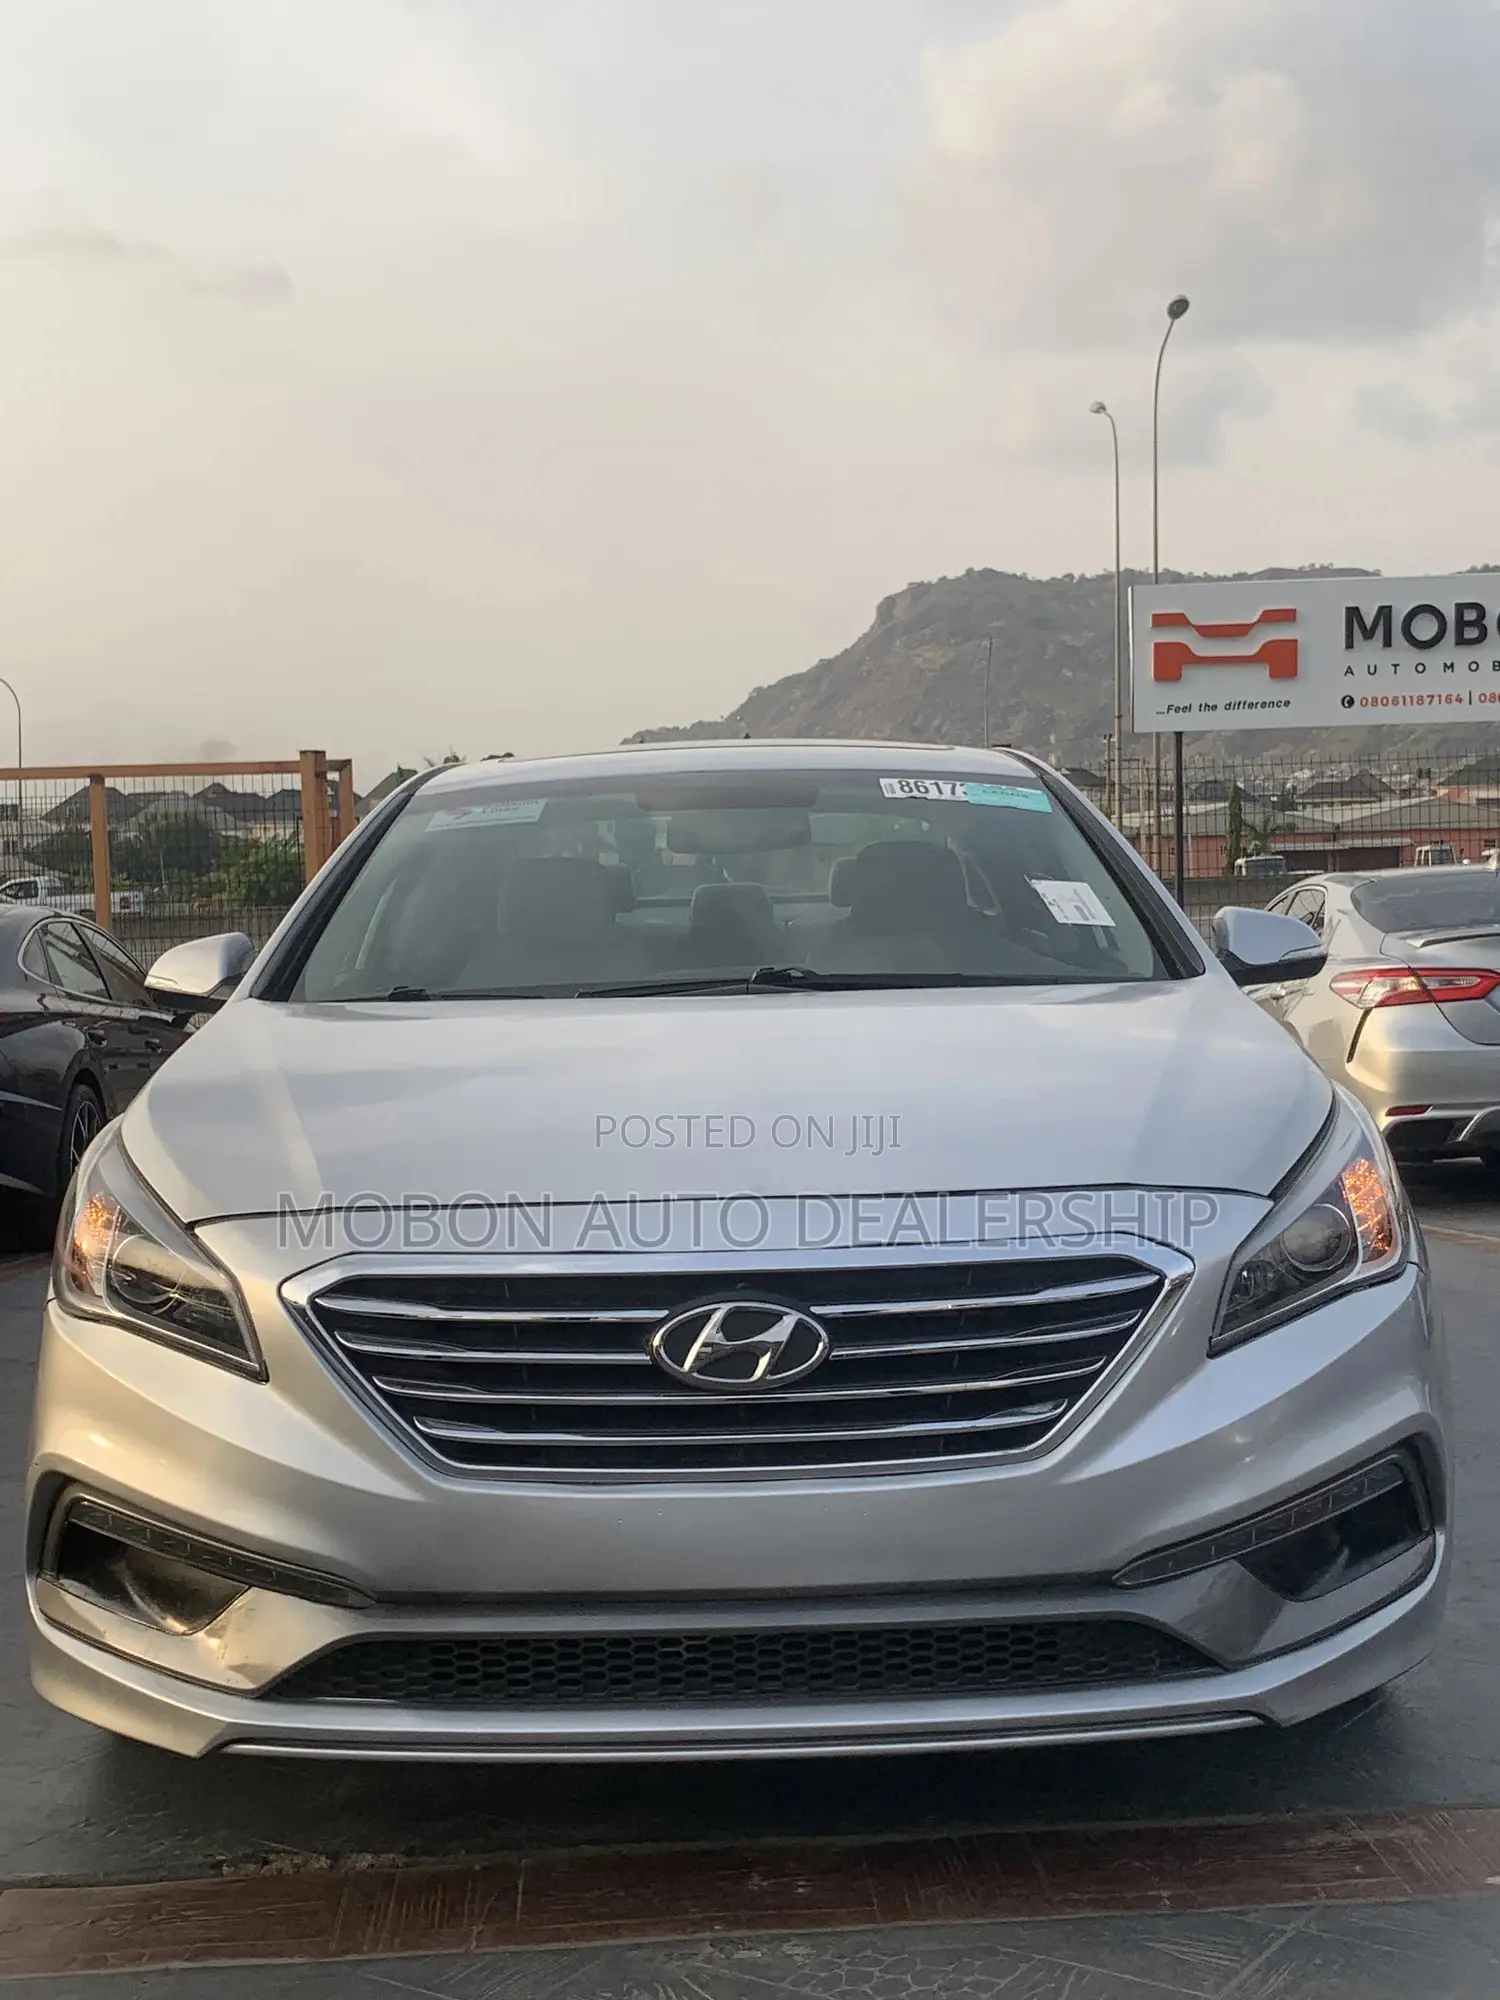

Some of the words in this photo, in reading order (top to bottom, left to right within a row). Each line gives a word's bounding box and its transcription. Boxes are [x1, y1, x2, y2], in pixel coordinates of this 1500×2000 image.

[1344, 602, 1500, 650] MOB
[1199, 702, 1218, 713] the
[1224, 699, 1291, 711] difference
[1360, 693, 1464, 708] 08061187164
[1478, 691, 1500, 704] 08
